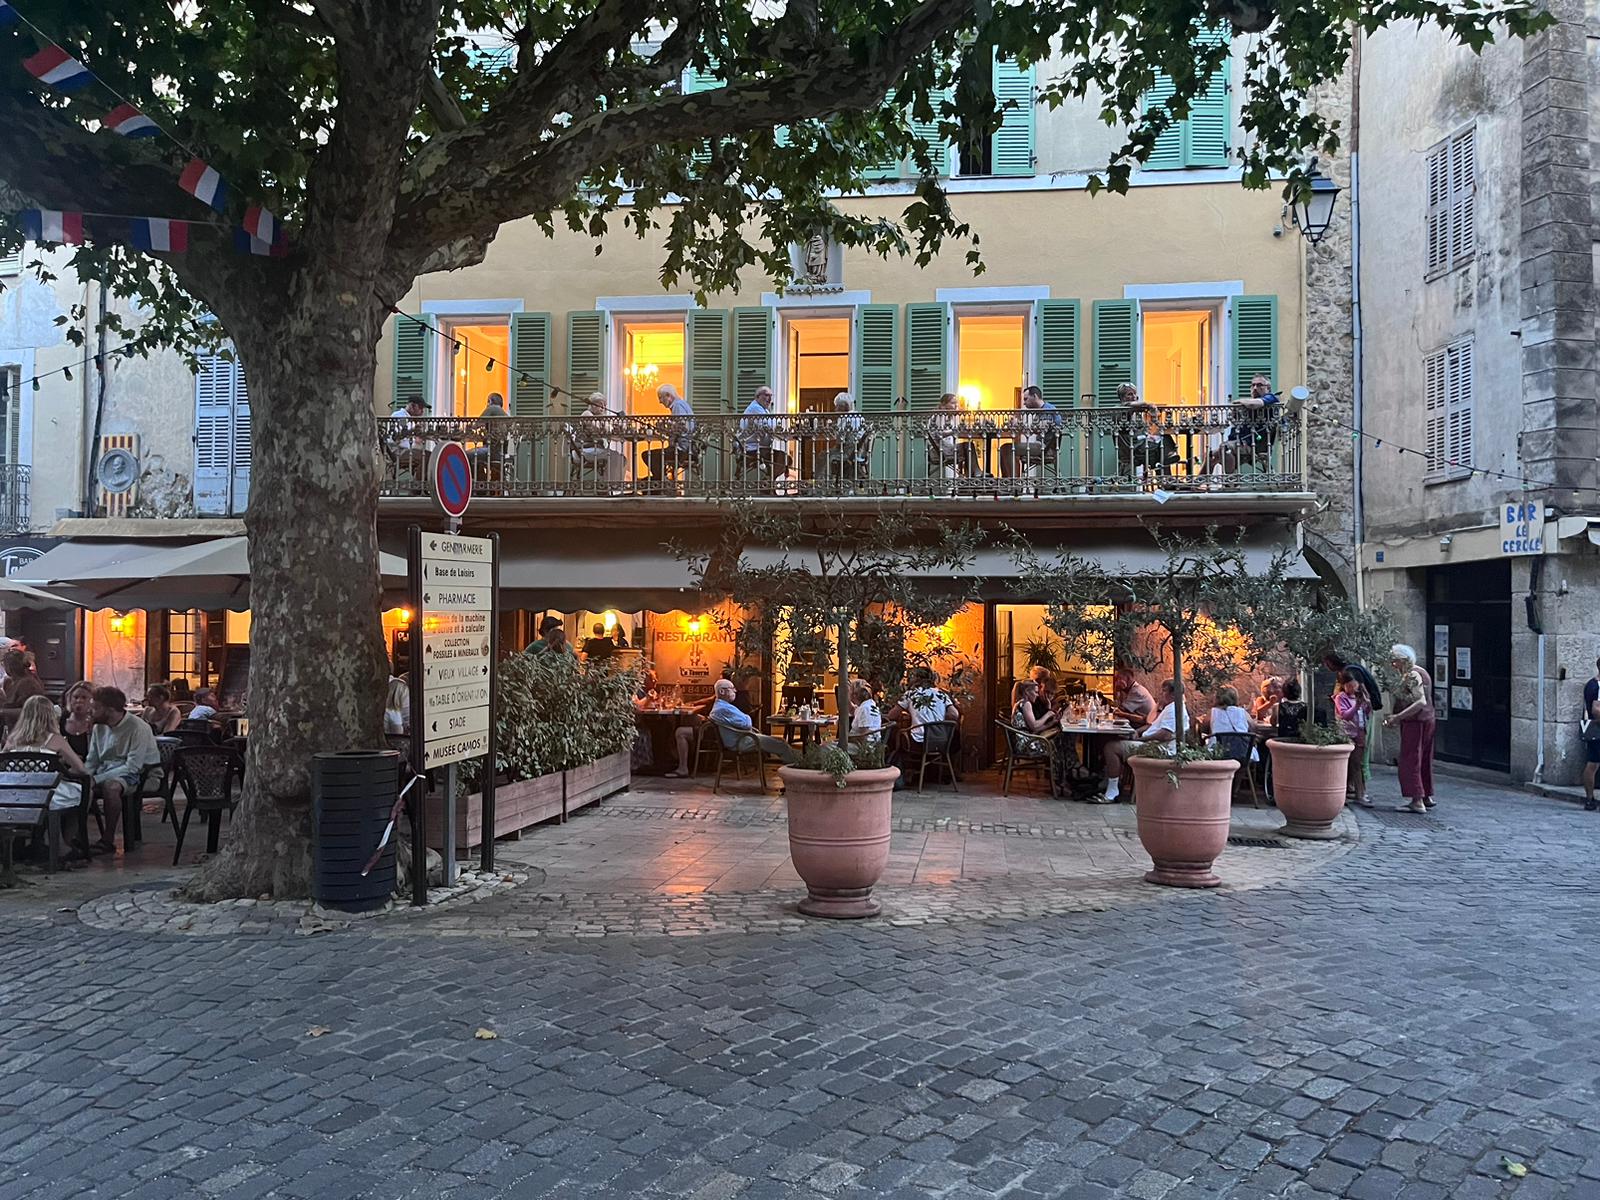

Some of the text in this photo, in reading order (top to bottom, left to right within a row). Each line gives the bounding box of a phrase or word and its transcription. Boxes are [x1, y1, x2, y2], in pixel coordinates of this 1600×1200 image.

[1506, 503, 1537, 524] BAR
[1516, 525, 1528, 538] LE
[441, 541, 483, 555] GENDARMERIE
[1503, 540, 1541, 553] CERCLE
[435, 567, 475, 578] Base de Loisirs
[439, 593, 476, 604] PHARMACIE
[465, 613, 486, 622] machine
[465, 624, 485, 633] calculer
[444, 638, 470, 647] COLLECTION
[433, 650, 453, 659] FOSSILES
[439, 665, 479, 680] VIEUX VILLAGE
[436, 687, 488, 706] TABLE D'ORIENTION
[449, 716, 466, 730] STADE
[433, 739, 481, 760] MUSÉE CAMOS
